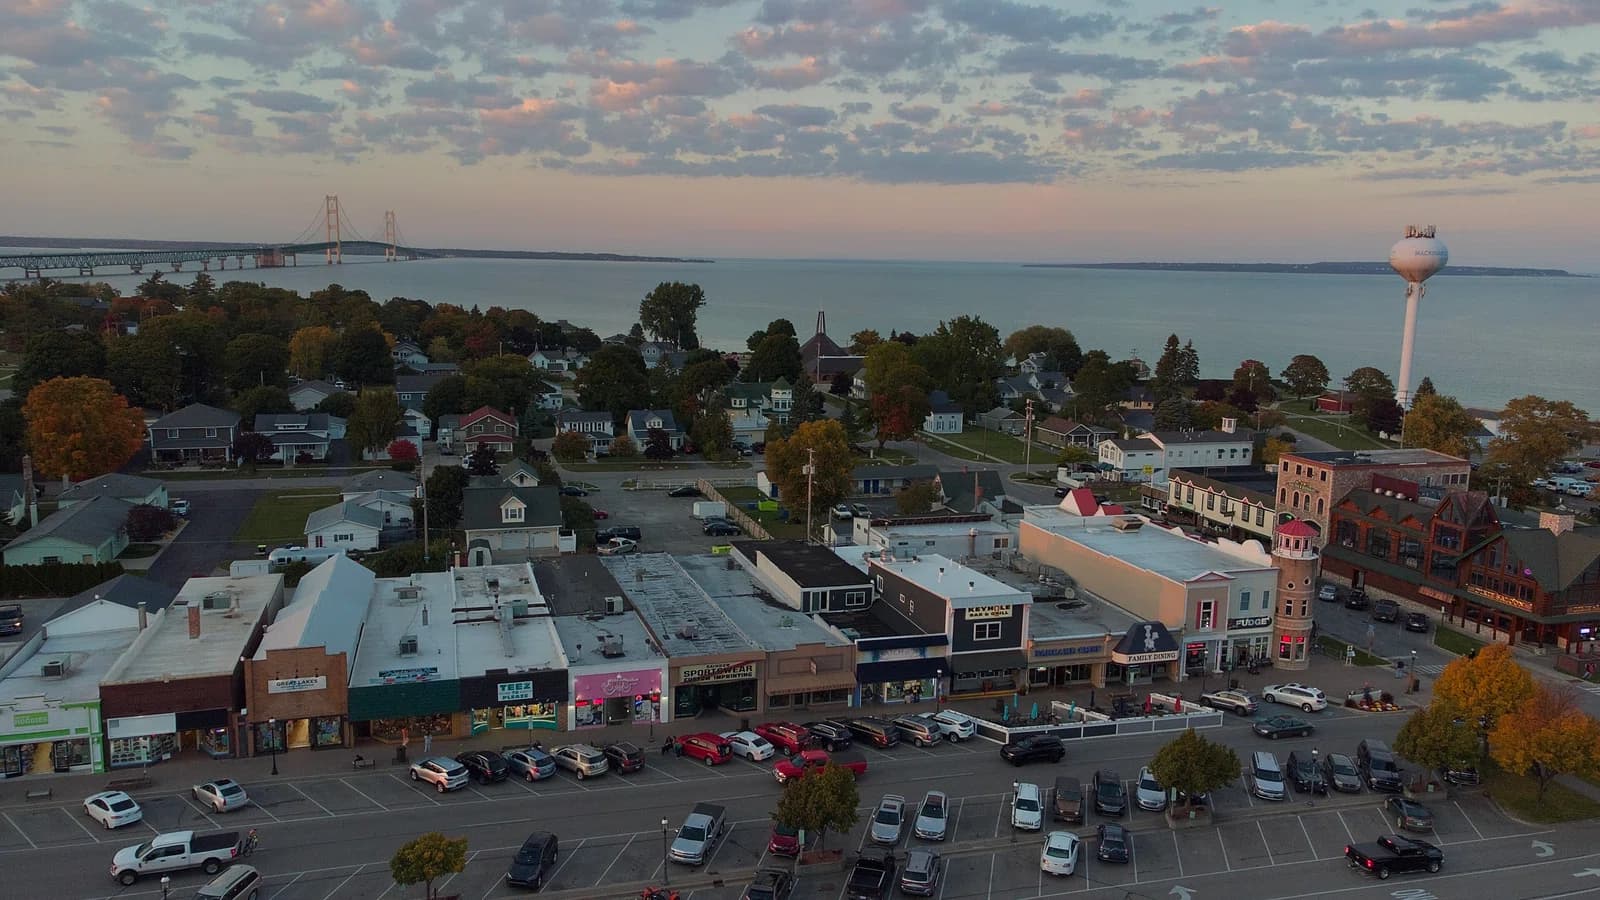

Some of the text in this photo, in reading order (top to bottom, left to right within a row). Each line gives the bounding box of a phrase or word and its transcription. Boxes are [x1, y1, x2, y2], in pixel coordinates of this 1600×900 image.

[968, 604, 1011, 613] KEYHOLE
[1235, 617, 1269, 627] FUDGE
[1128, 652, 1176, 662] FAMILY DINING
[499, 683, 531, 691] TEEZ
